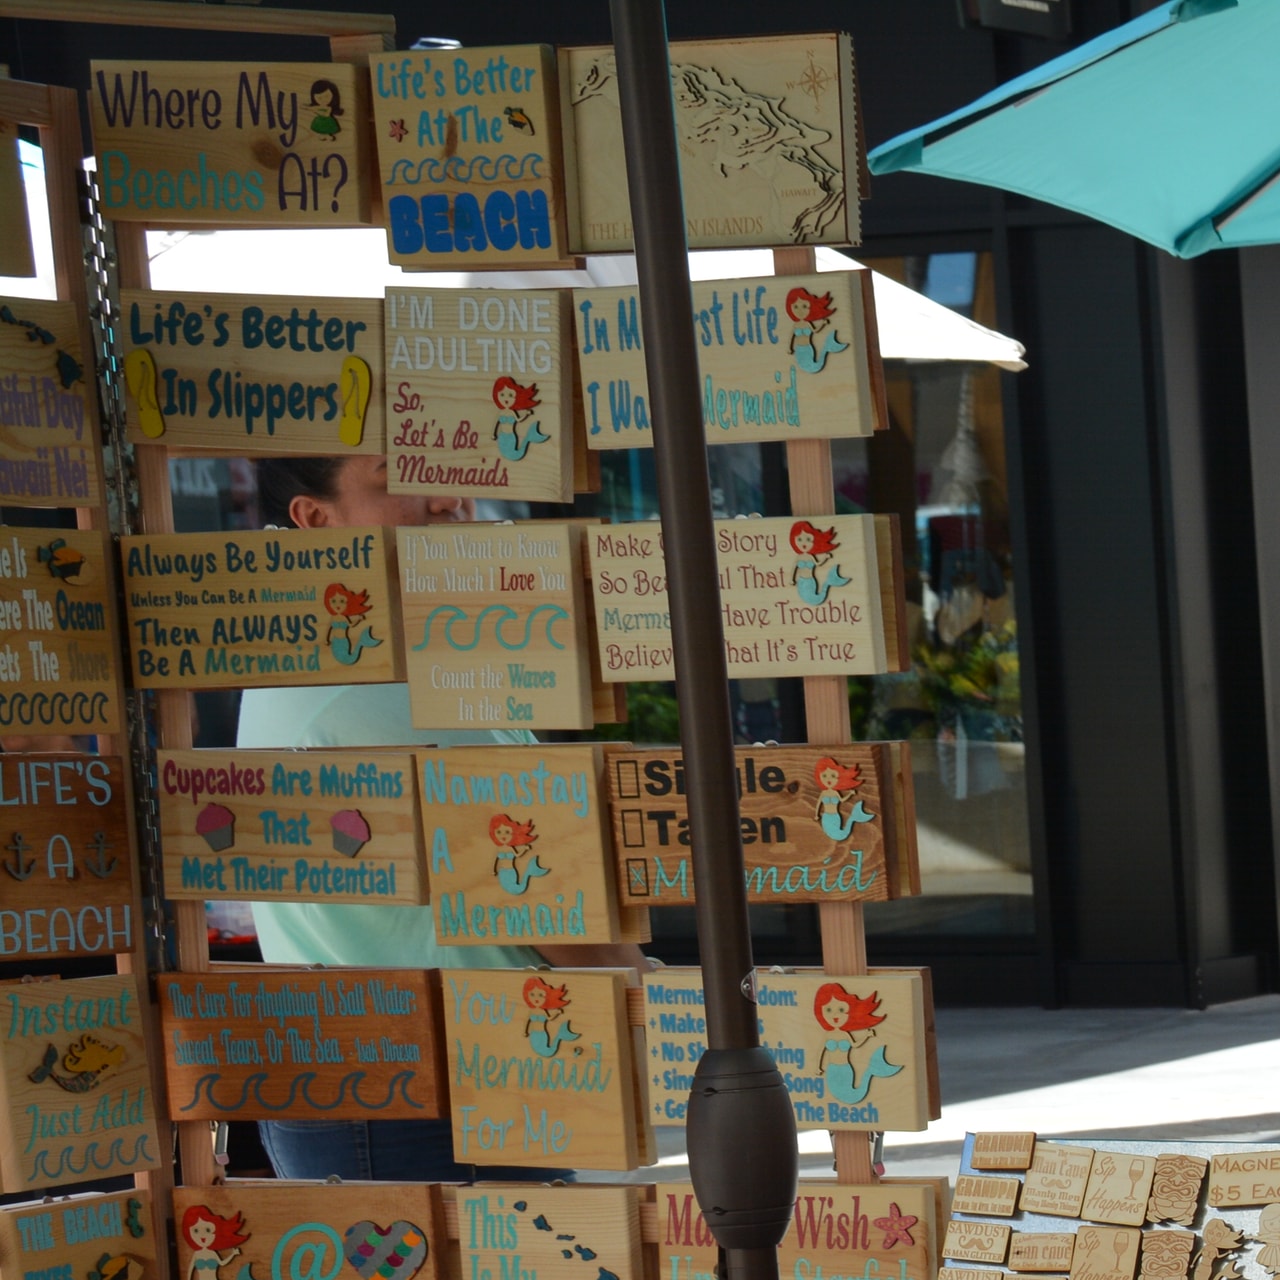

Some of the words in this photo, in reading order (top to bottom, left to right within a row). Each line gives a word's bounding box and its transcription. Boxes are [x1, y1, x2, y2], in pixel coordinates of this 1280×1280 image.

[377, 60, 446, 98] Life's
[455, 56, 535, 95] Better
[96, 70, 221, 130] Where
[236, 71, 298, 148] My
[418, 110, 447, 147] At
[458, 106, 503, 144] The
[103, 150, 265, 212] Beaches
[278, 153, 348, 213] At?
[389, 190, 551, 255] BEACH
[130, 302, 229, 346] Life's
[242, 308, 366, 353] Better
[390, 295, 433, 329] I'M
[459, 298, 551, 333] DONE
[579, 300, 610, 355] In
[733, 285, 778, 346] Life
[392, 338, 552, 374] ADULTING
[161, 369, 196, 415] In
[208, 368, 338, 436] Slippers
[393, 382, 424, 413] So,
[395, 421, 445, 449] Let's
[454, 421, 478, 450] Be
[398, 455, 508, 487] Mermaids
[128, 544, 216, 582] Always
[226, 542, 258, 573] Be
[266, 535, 373, 572] Yourself
[405, 535, 421, 561] If
[423, 535, 449, 560] You
[452, 534, 493, 559] Want
[498, 537, 514, 559] to
[518, 533, 559, 559] Know
[597, 535, 653, 557] Make
[718, 530, 777, 557] Story
[131, 591, 171, 607] Unless
[176, 590, 198, 607] You
[202, 590, 225, 605] Can
[230, 589, 244, 604] Be
[248, 589, 257, 603] A
[261, 587, 316, 602] Mermaid
[405, 569, 439, 593] How
[443, 568, 485, 593] Much
[490, 567, 495, 591] I
[500, 567, 534, 592] Love
[538, 565, 566, 591] You
[22, 589, 53, 630] The
[57, 590, 104, 631] Ocean
[135, 618, 199, 647] Then
[213, 614, 318, 644] ALWAYS
[775, 601, 862, 625] Trouble
[139, 649, 169, 676] Be
[180, 649, 196, 676] A
[205, 646, 320, 675] Mermaid
[768, 639, 797, 662] It's
[804, 637, 855, 663] True
[432, 665, 475, 690] Count
[480, 664, 503, 688] the
[508, 663, 556, 689] Waves
[0, 761, 111, 806] LIFE'S
[164, 760, 265, 805] Cupcakes
[271, 762, 313, 796] Are
[319, 763, 403, 799] Muffins
[424, 758, 588, 817] Namastay
[259, 810, 312, 846] That
[47, 834, 74, 879] A
[432, 827, 454, 873] A
[181, 857, 226, 891] Met
[231, 857, 288, 891] Their
[299, 858, 396, 895] Potential
[0, 904, 131, 955] BEACH
[440, 890, 585, 938] Mermaid
[7, 988, 132, 1039] Instant
[449, 978, 514, 1025] You
[455, 1038, 612, 1092] Mermaid
[25, 1103, 82, 1153] Just
[89, 1087, 146, 1130] Add
[460, 1106, 513, 1154] For
[523, 1105, 573, 1154] Me
[1085, 1188, 1143, 1214] Happens
[1211, 1185, 1241, 1200] $5
[18, 1216, 58, 1253] THE
[64, 1201, 123, 1246] BEACH
[466, 1195, 518, 1250] This
[796, 1196, 871, 1250] Wish
[948, 1221, 1009, 1238] SAWDUST
